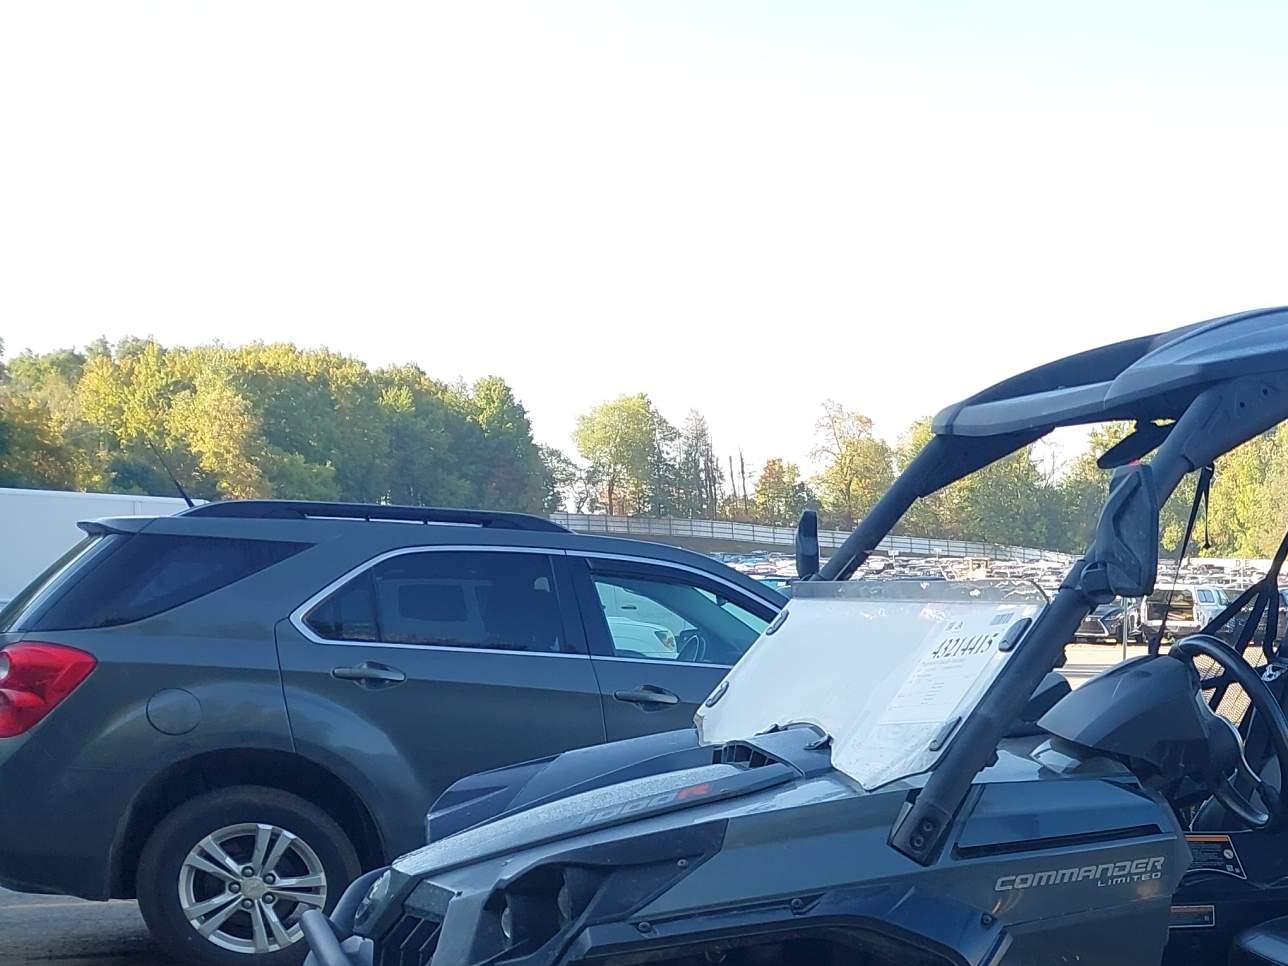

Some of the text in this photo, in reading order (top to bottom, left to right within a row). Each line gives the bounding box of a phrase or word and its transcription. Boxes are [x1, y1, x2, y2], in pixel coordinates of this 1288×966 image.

[932, 632, 999, 660] 43214415
[994, 856, 1165, 892] COMMANDER
[1097, 871, 1162, 888] LIMITED
